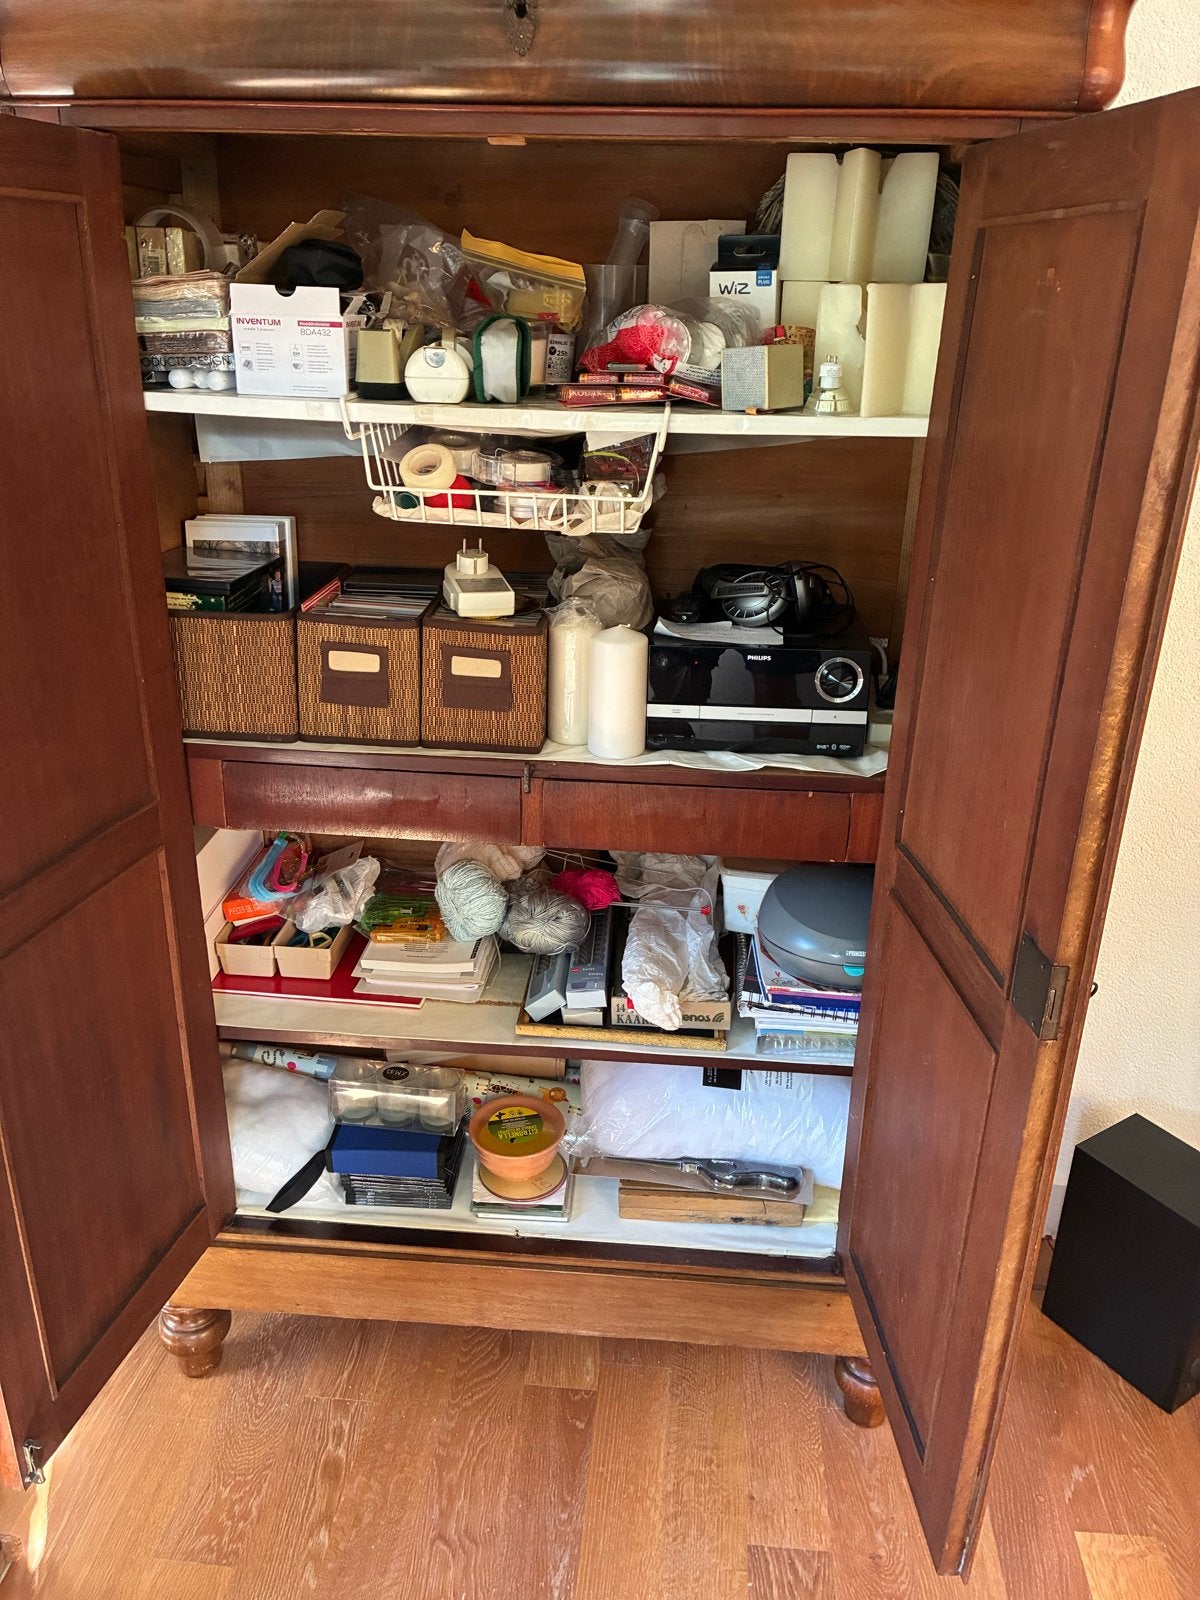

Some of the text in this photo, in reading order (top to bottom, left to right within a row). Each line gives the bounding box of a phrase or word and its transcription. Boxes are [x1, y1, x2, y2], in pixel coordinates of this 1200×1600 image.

[718, 281, 751, 295] WiZ
[236, 317, 281, 326] INVENTUM
[300, 328, 332, 337] BDA432
[616, 1003, 626, 1012] 14
[616, 1014, 653, 1025] KAAR
[681, 1013, 711, 1022] enos
[498, 1127, 539, 1140] CITRONELLA
